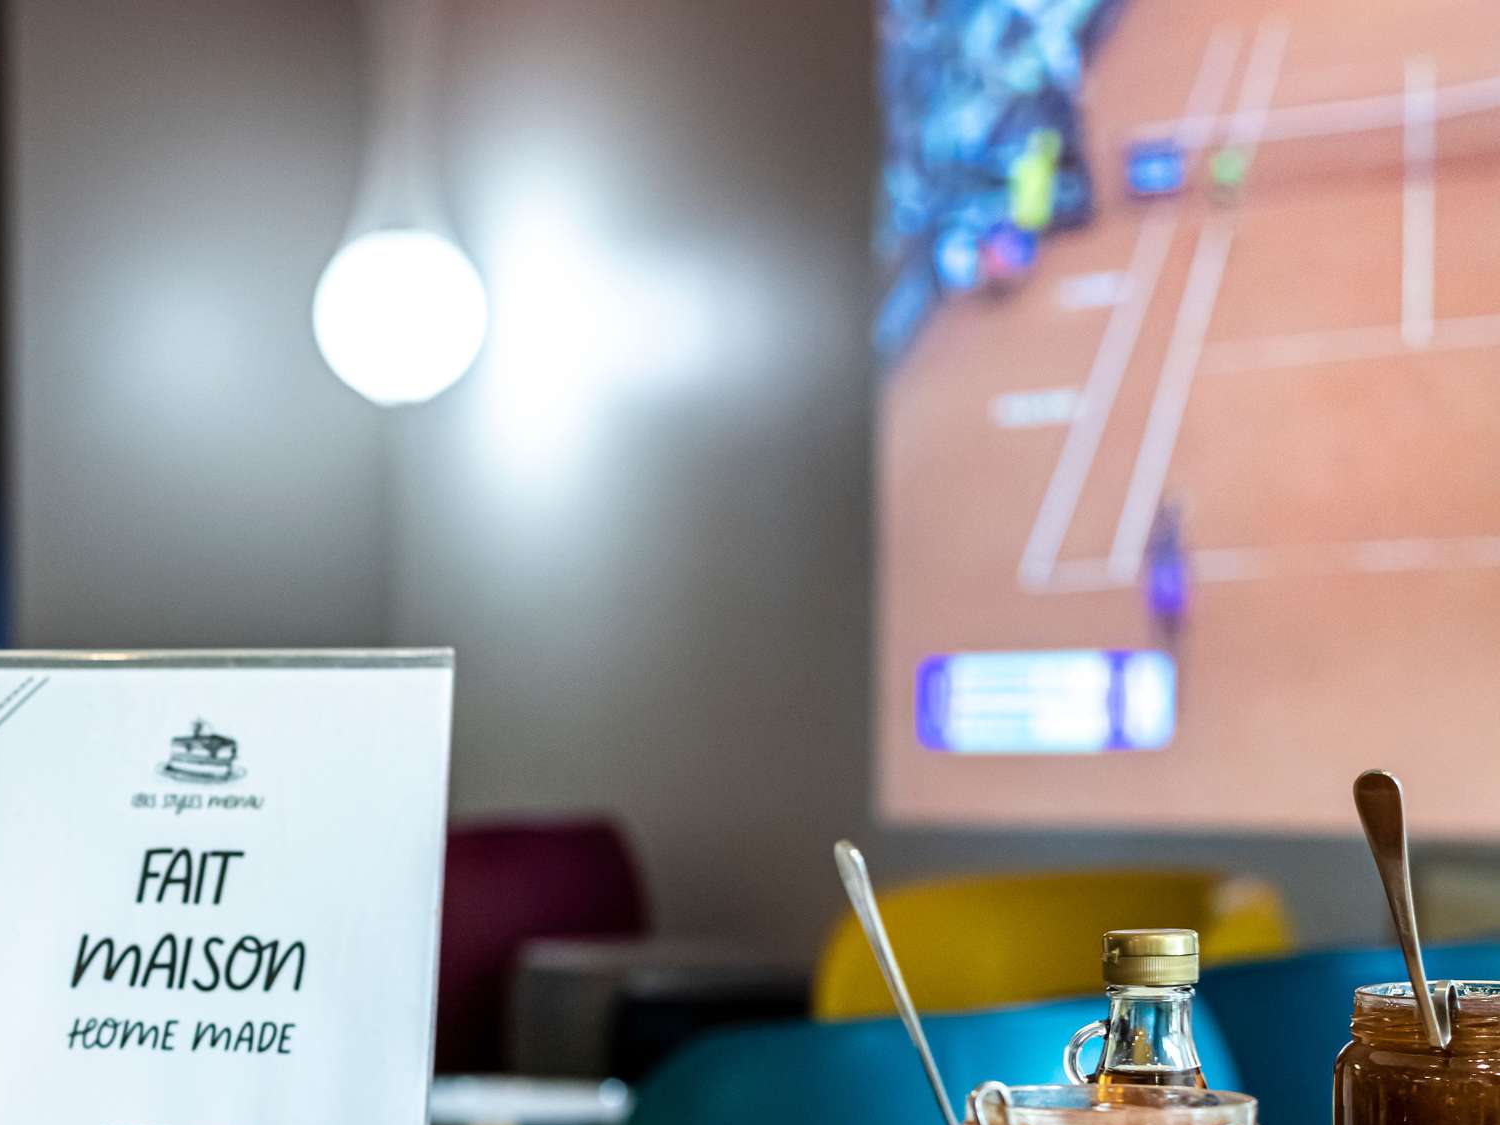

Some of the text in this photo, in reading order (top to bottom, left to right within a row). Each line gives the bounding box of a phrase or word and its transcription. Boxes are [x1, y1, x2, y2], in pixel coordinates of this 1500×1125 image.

[135, 846, 246, 906] FAIT
[69, 931, 308, 994] MAISON
[67, 1016, 297, 1056] HOME MADE
